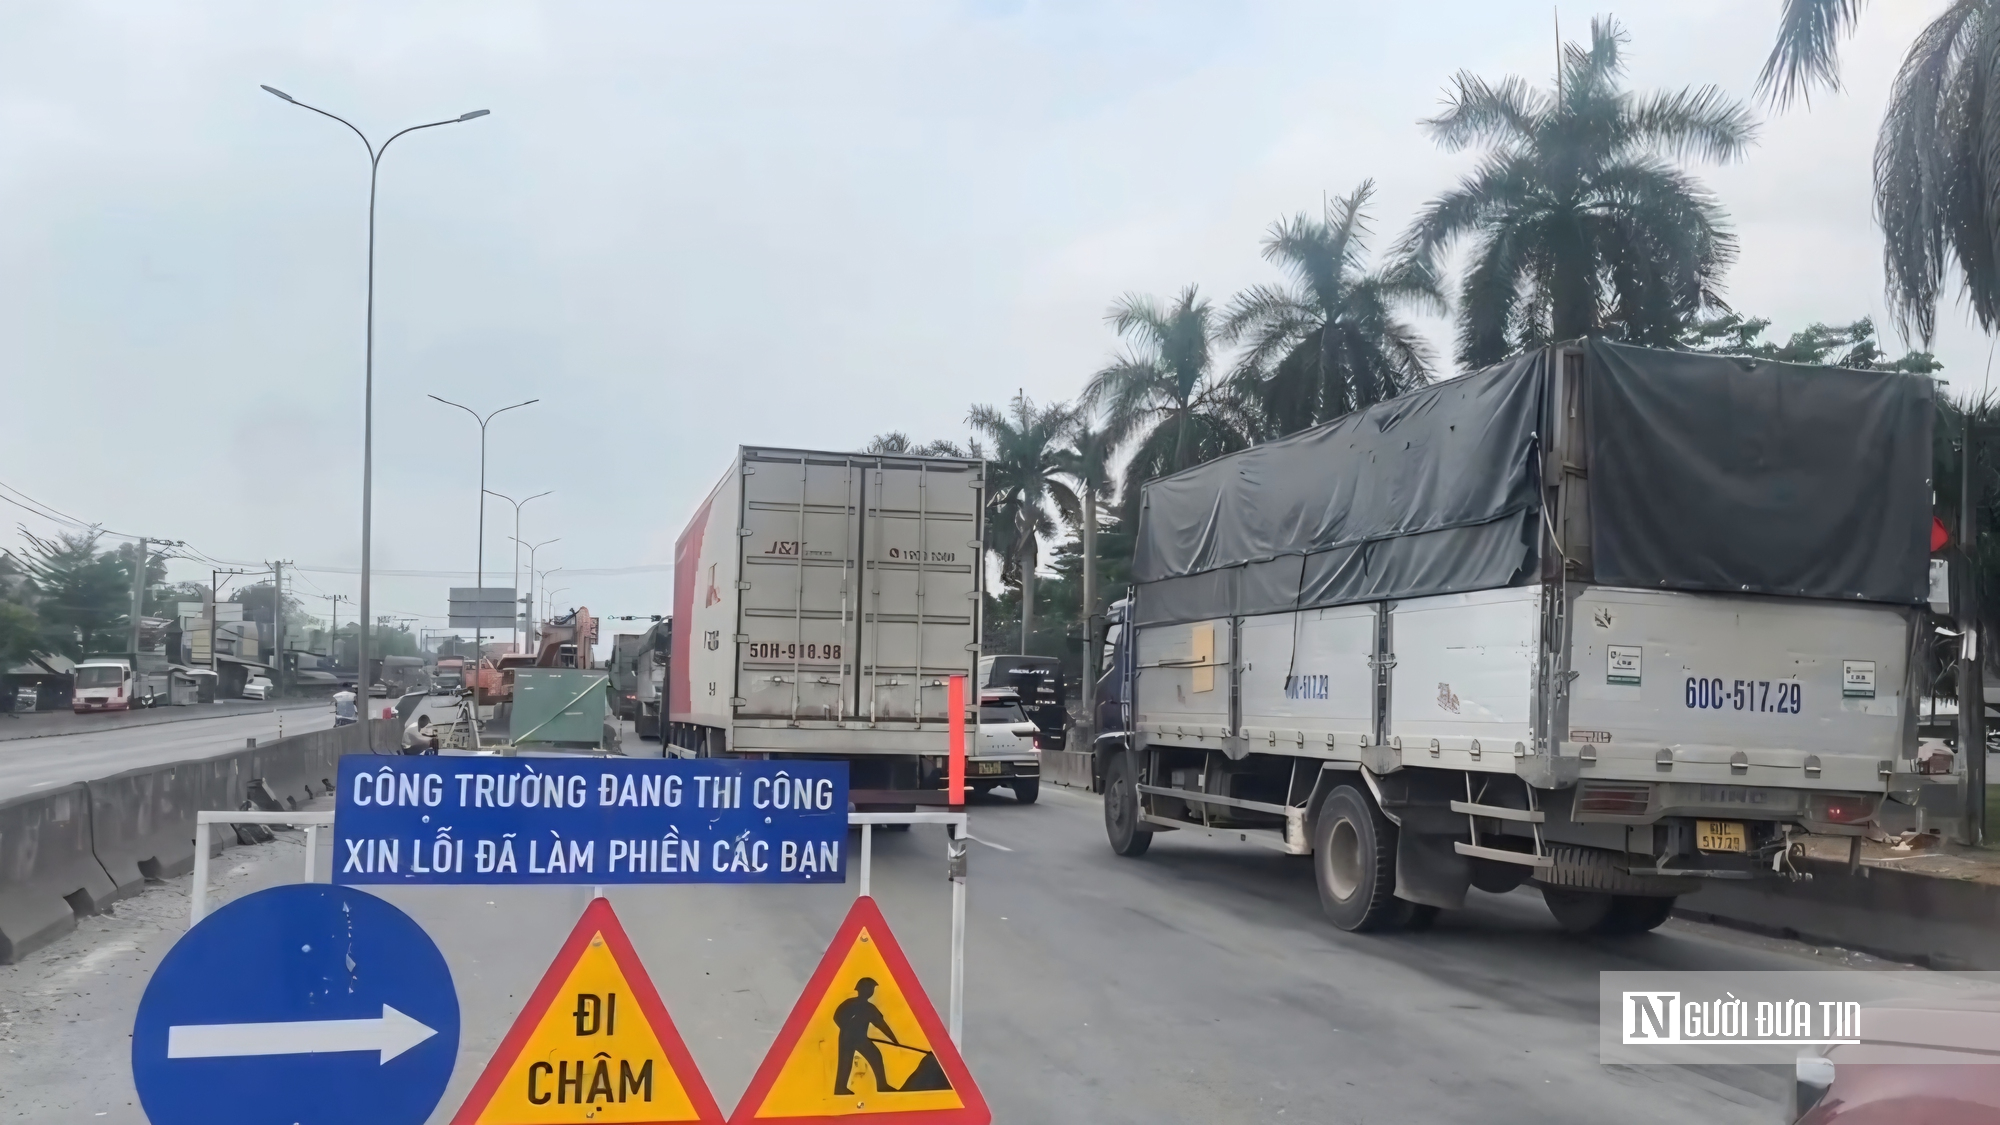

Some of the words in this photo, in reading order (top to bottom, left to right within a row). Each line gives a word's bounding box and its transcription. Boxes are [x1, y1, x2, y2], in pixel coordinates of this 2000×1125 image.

[1685, 677, 1801, 714] 60C-517.29
[353, 765, 443, 807] CÔNG
[454, 764, 587, 808] TRƯỜNG
[597, 773, 683, 807] ĐANG
[693, 775, 742, 809] THI
[752, 770, 834, 810] CÔNG
[342, 838, 399, 873] XIN
[412, 826, 464, 873] LỖI
[474, 833, 518, 873] ĐÃ
[529, 830, 595, 873] LÀM
[609, 824, 700, 873] PHIỀN
[712, 829, 769, 873] CÁC
[780, 840, 839, 879] BẠN
[572, 993, 616, 1036] ĐI
[528, 1051, 653, 1112] CHẬM
